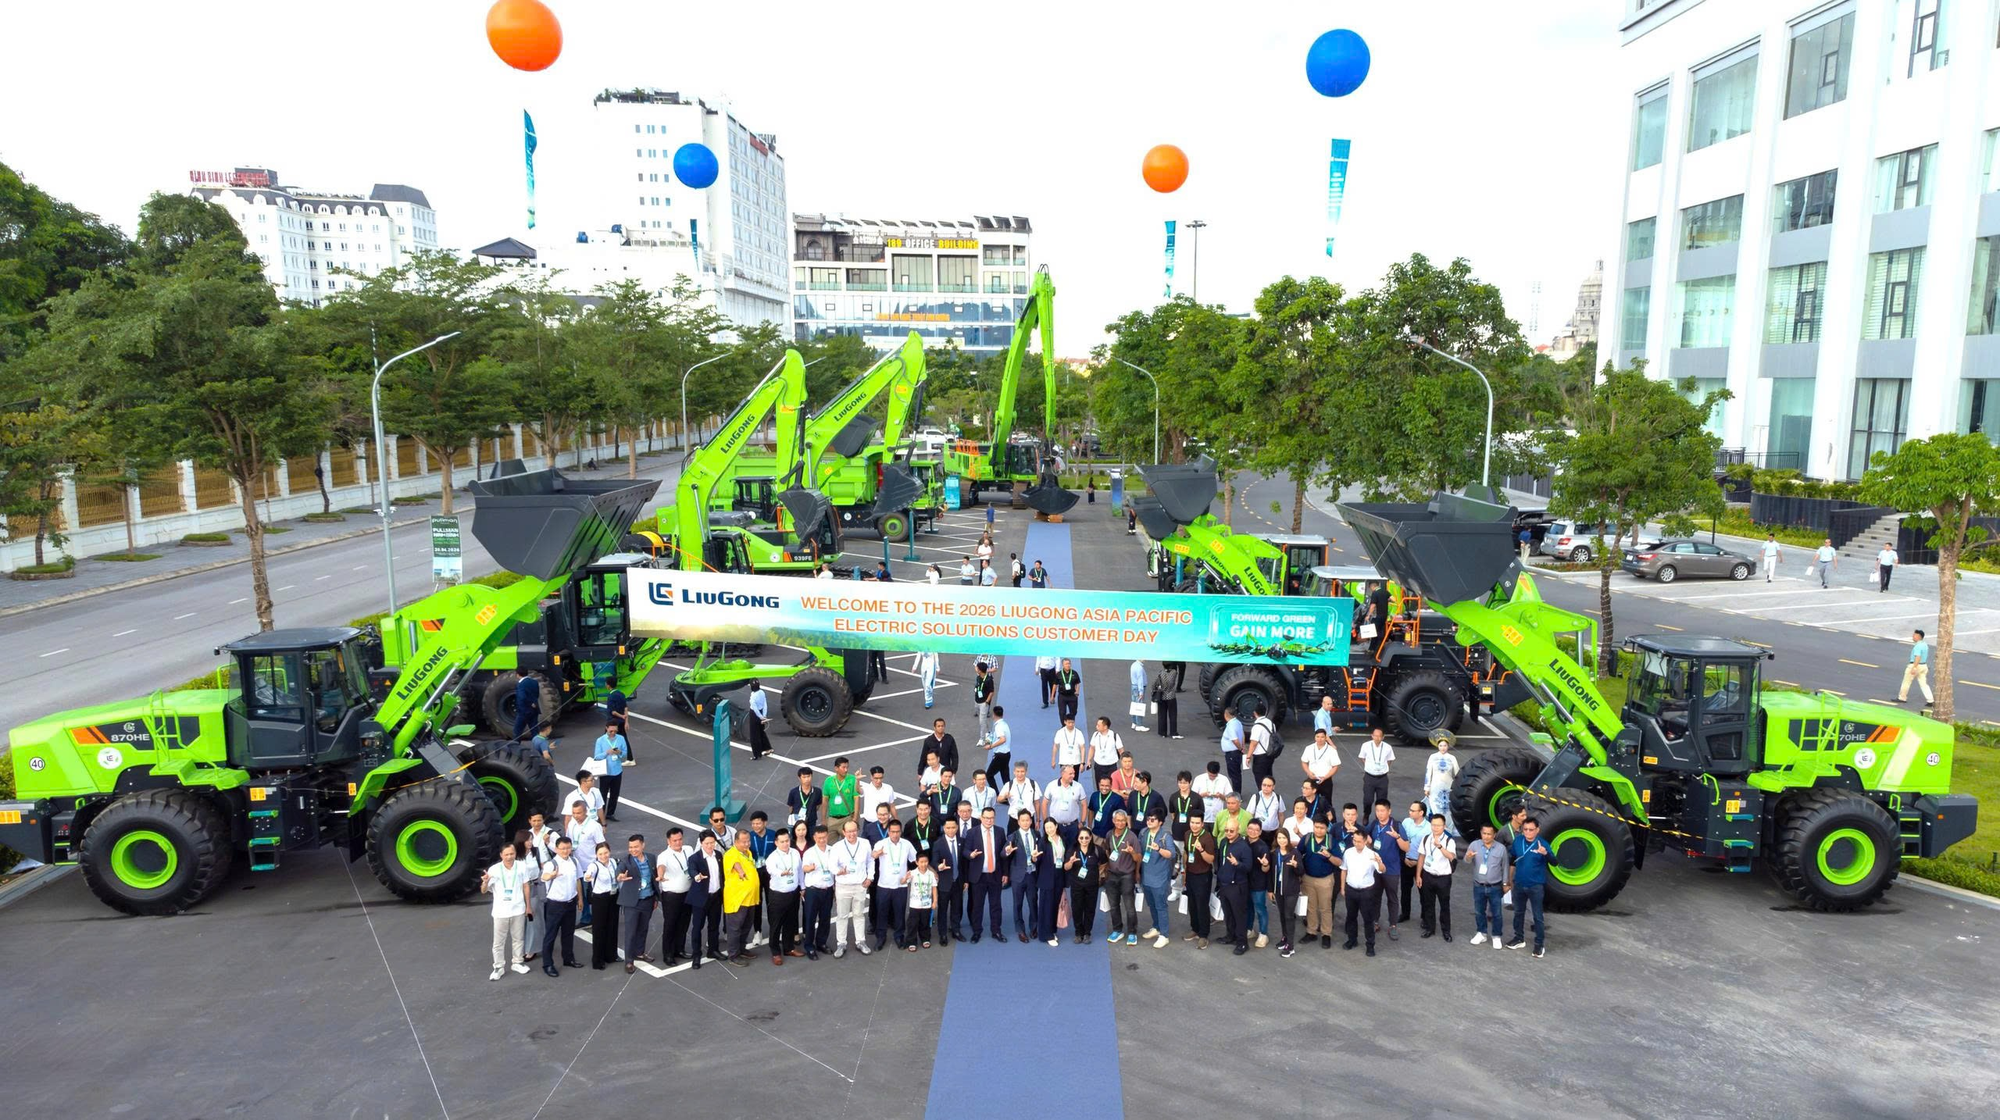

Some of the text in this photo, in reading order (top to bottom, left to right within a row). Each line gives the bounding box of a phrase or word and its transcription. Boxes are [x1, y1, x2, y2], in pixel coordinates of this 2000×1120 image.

[905, 239, 935, 249] OFFICE
[938, 239, 978, 249] BUILDING
[801, 596, 1192, 624] WELCOME TO THE 2026 LIUGONG ASIA PACIFIC
[1231, 613, 1316, 624] FORWARD GREEN
[834, 618, 1158, 643] ELECTRIC SOLUTIONS CUSTOMER DAY
[1230, 625, 1316, 639] GAIN MORE
[111, 733, 150, 742] 870HE
[1838, 733, 1866, 742] 70HE
[31, 759, 44, 768] 40
[1927, 754, 1938, 763] 40
